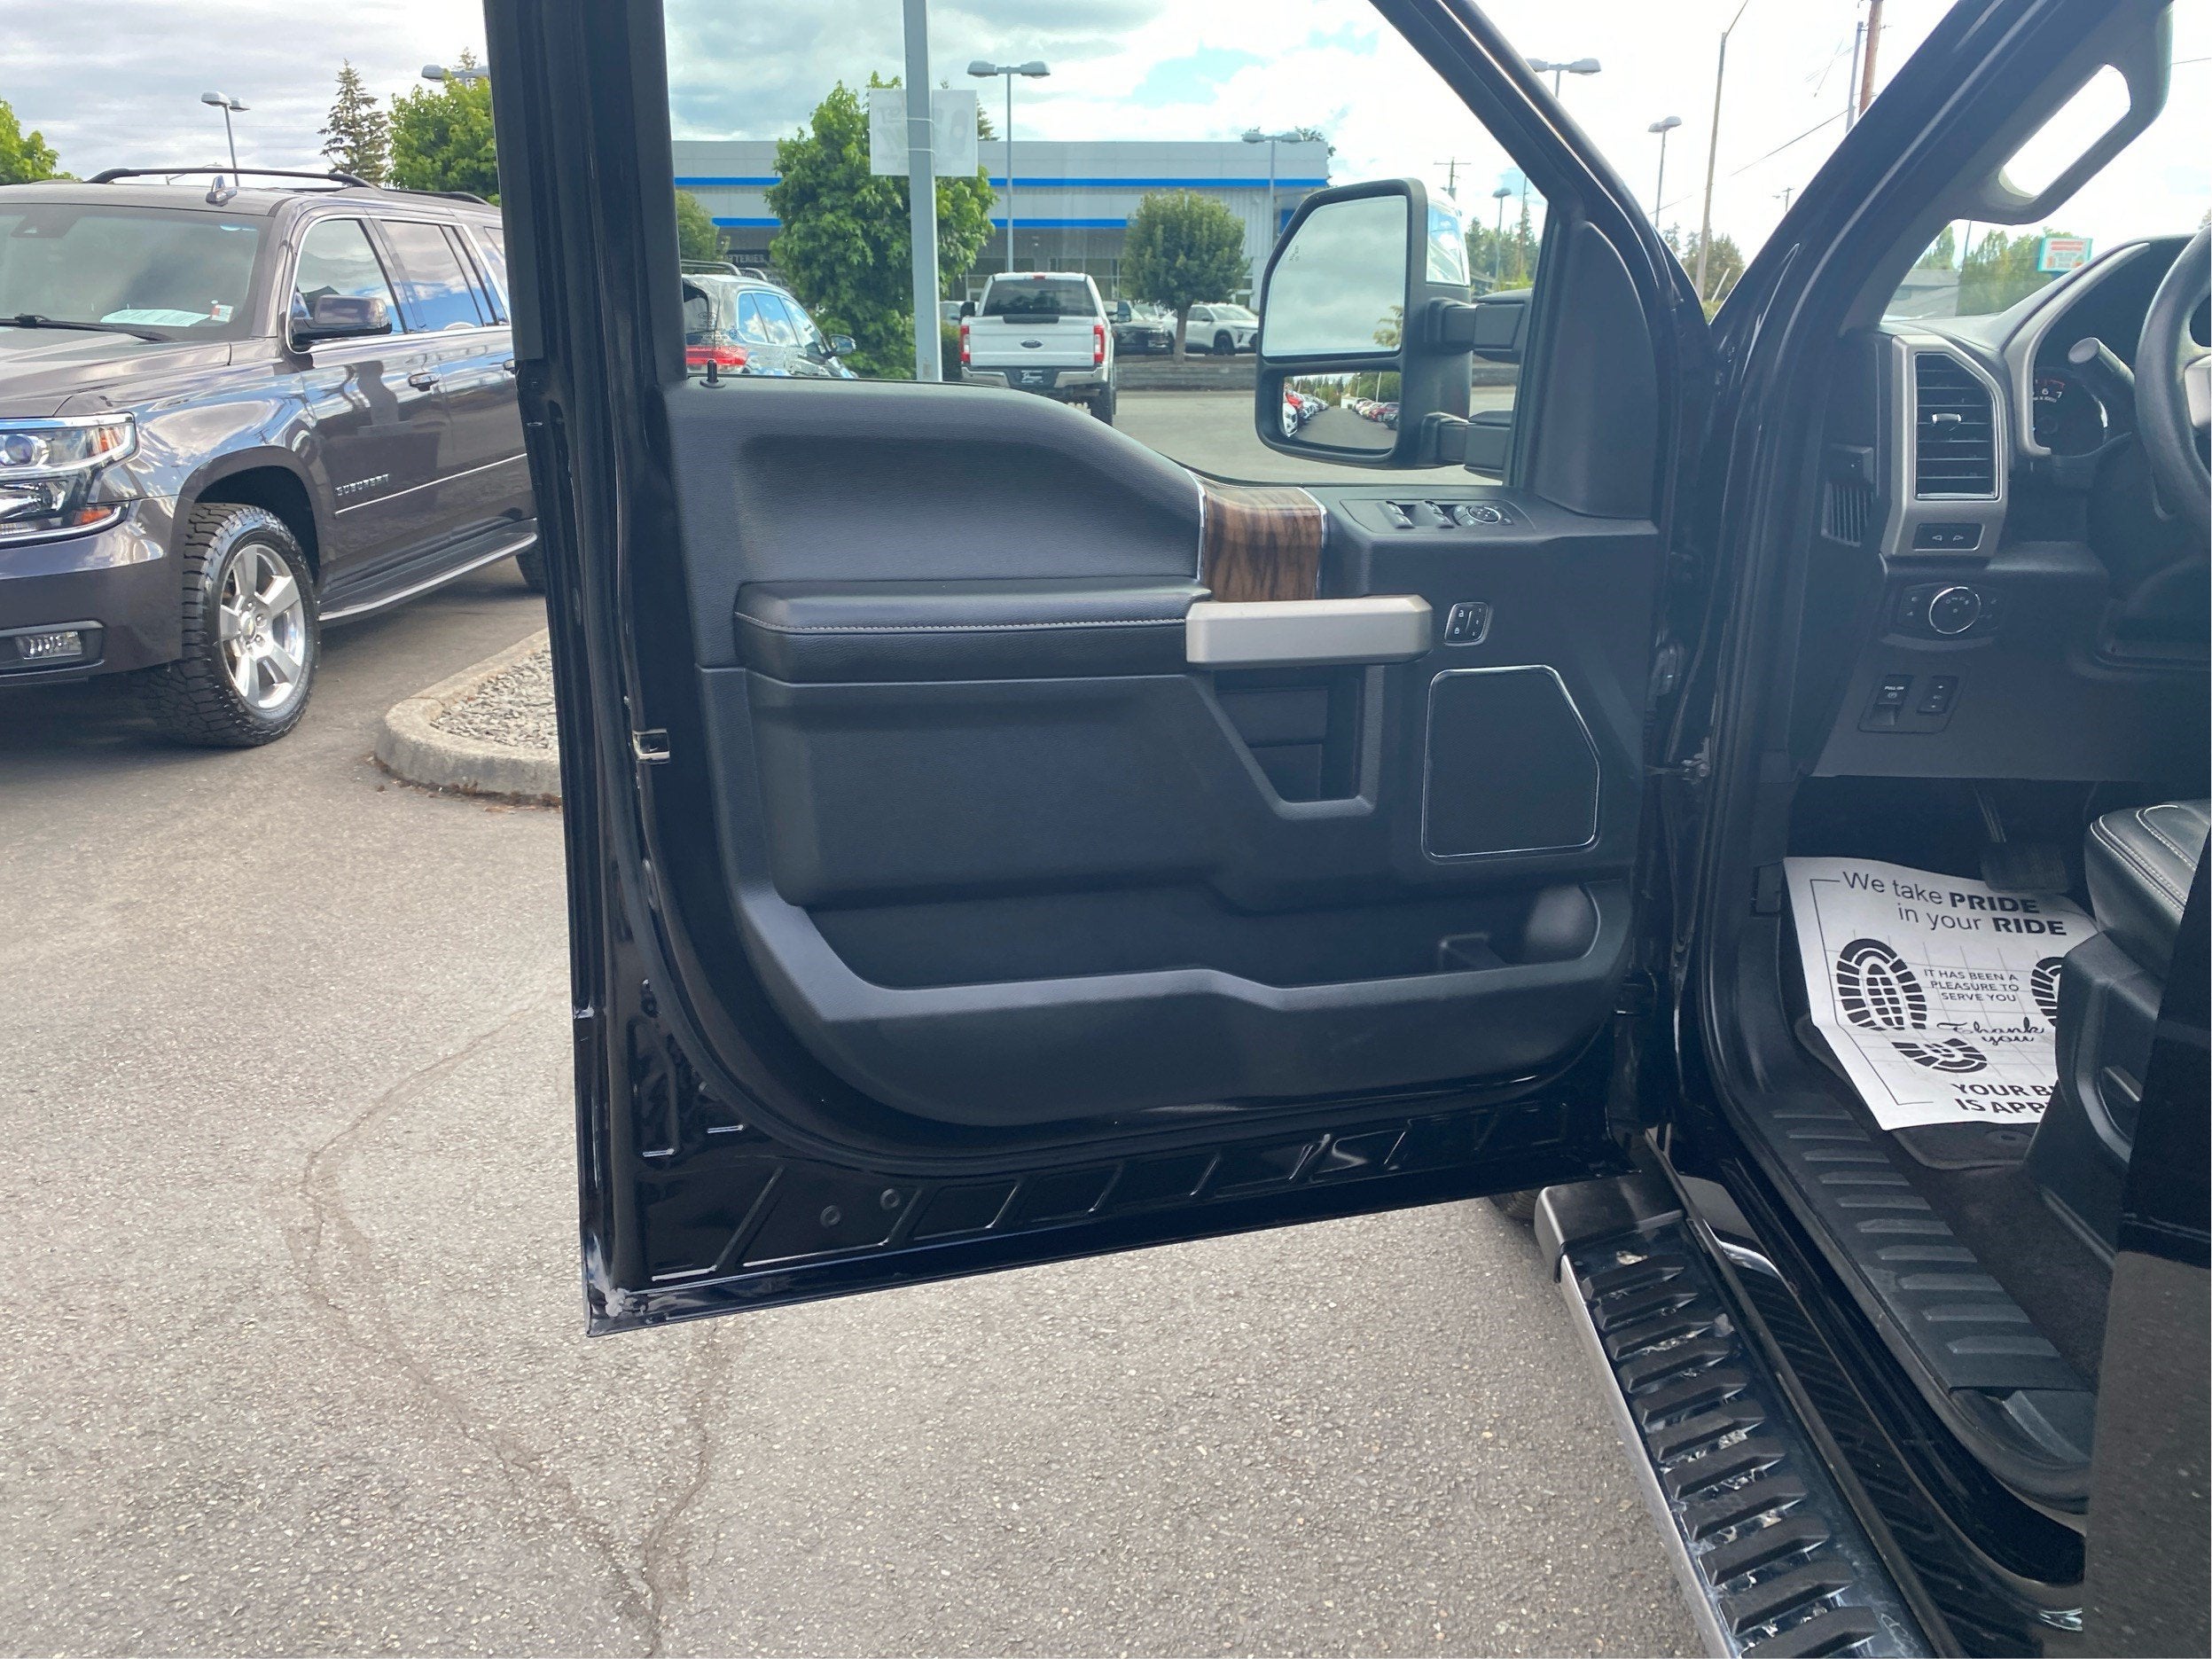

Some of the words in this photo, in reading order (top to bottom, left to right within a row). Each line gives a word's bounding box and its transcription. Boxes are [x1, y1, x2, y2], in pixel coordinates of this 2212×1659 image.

[1842, 871, 1885, 893] We
[1892, 880, 1943, 904] take
[1950, 892, 2041, 914] PRIDE
[1897, 903, 1919, 923] in
[1926, 912, 1981, 931] your
[1992, 917, 2067, 936] RIDE
[1924, 968, 1935, 977] IT
[1938, 969, 1966, 980] HAS
[1968, 972, 2004, 981] BEEN
[1930, 981, 1998, 991] PLEASURE
[2001, 983, 2020, 992] TO
[1941, 992, 1983, 1001] SERVE
[1936, 1016, 2044, 1034] Thank
[1981, 1036, 2035, 1046] you
[1950, 1083, 2031, 1097] YOUR
[2029, 1084, 2055, 1097] B
[1954, 1098, 1986, 1112] IS
[1990, 1101, 2050, 1114] APP
